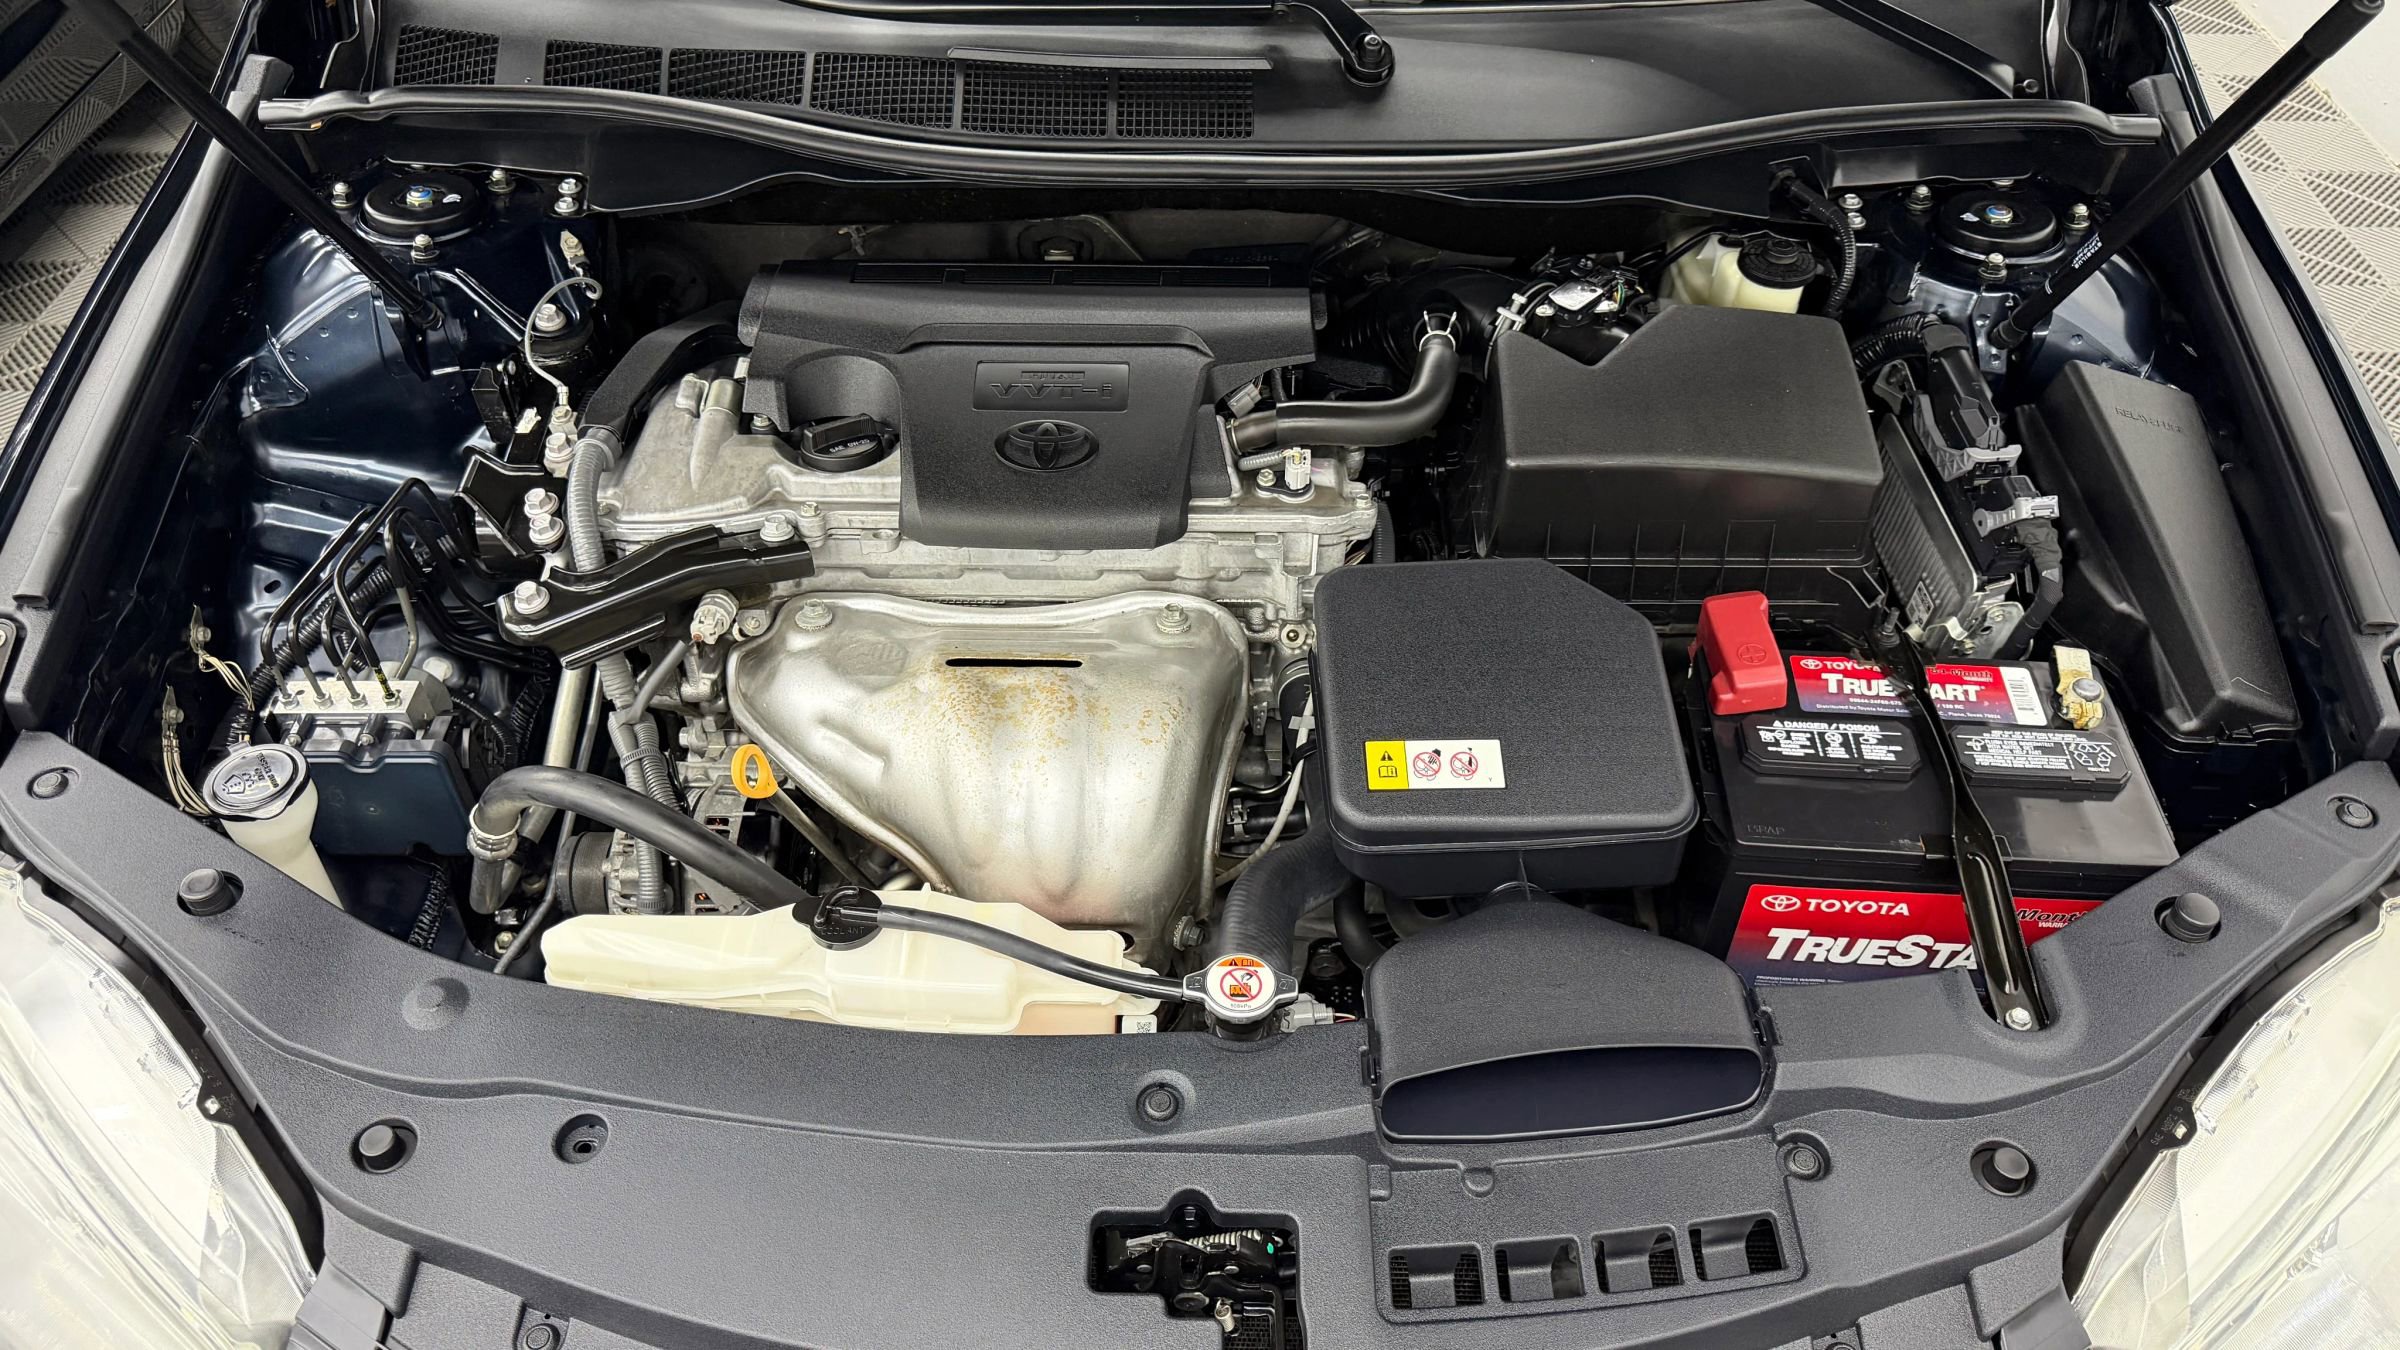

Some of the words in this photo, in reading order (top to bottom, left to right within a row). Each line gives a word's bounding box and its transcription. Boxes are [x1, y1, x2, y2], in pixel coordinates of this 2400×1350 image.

[990, 383, 1112, 399] VVT-i
[829, 445, 845, 453] SAE
[847, 438, 870, 448] 0W-20
[1783, 721, 1829, 730] DANGER
[1838, 723, 1880, 732] POISON
[1806, 899, 1910, 916] TOYOTA
[2016, 908, 2089, 922] Mont
[1766, 927, 1978, 970] TRUESTA
